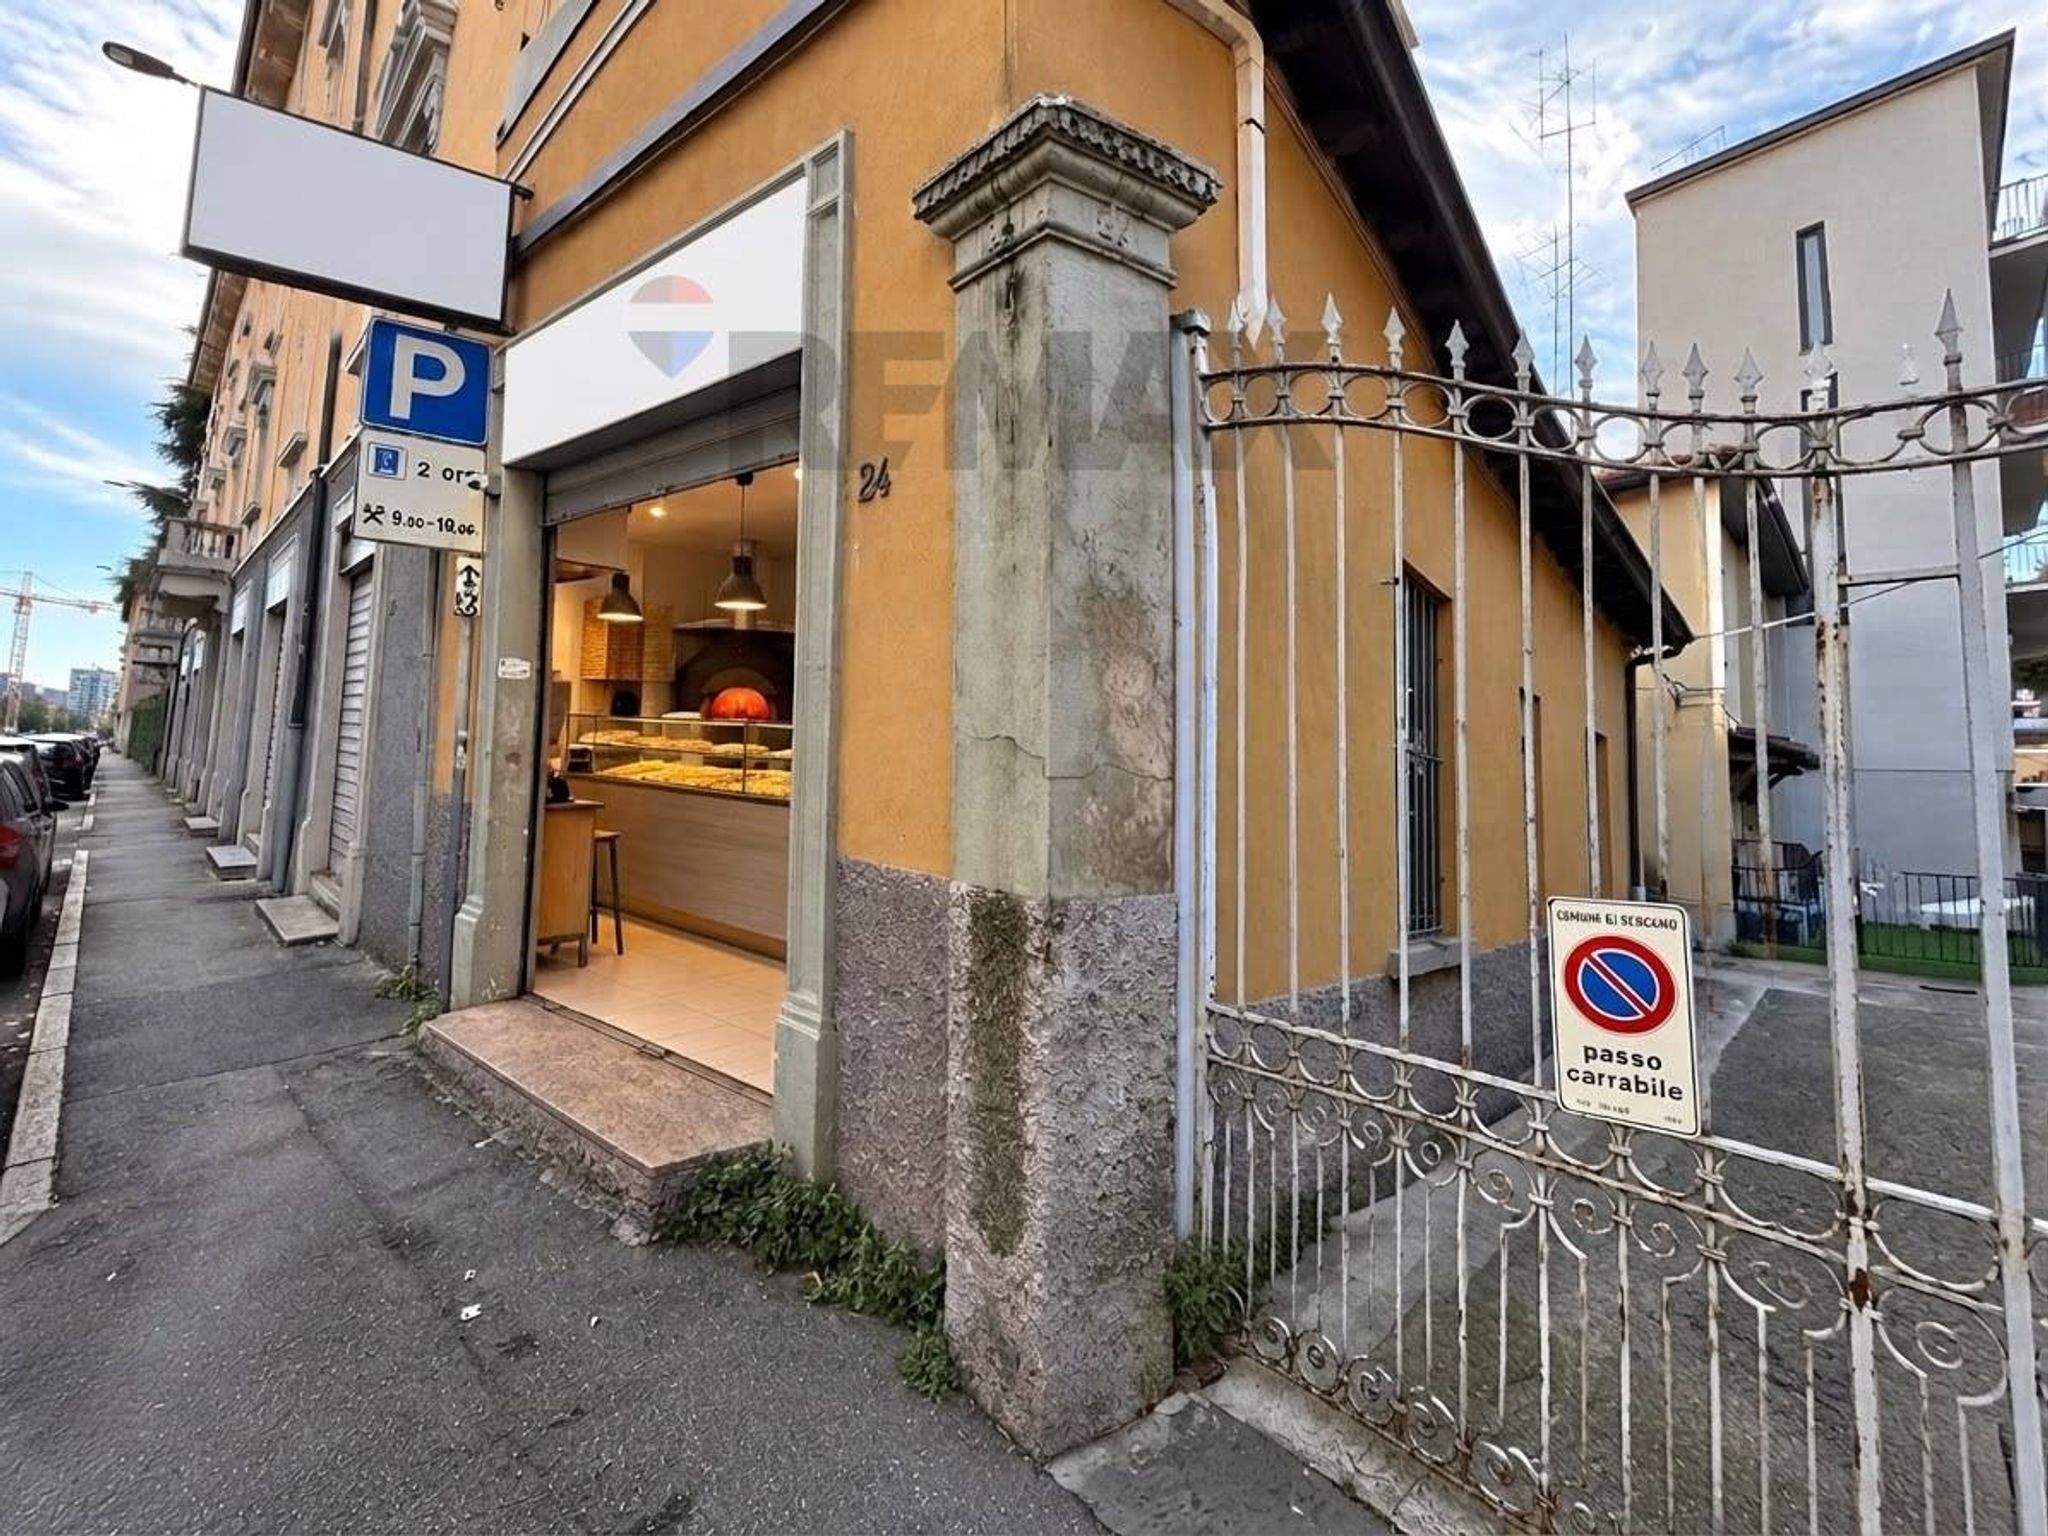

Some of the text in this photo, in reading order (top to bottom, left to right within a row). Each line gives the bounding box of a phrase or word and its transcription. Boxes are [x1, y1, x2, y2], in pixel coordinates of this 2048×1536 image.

[388, 333, 466, 420] P
[417, 461, 430, 478] 2
[858, 456, 892, 503] 24
[1584, 1045, 1662, 1071] passo
[1566, 1067, 1683, 1100] carrabile
